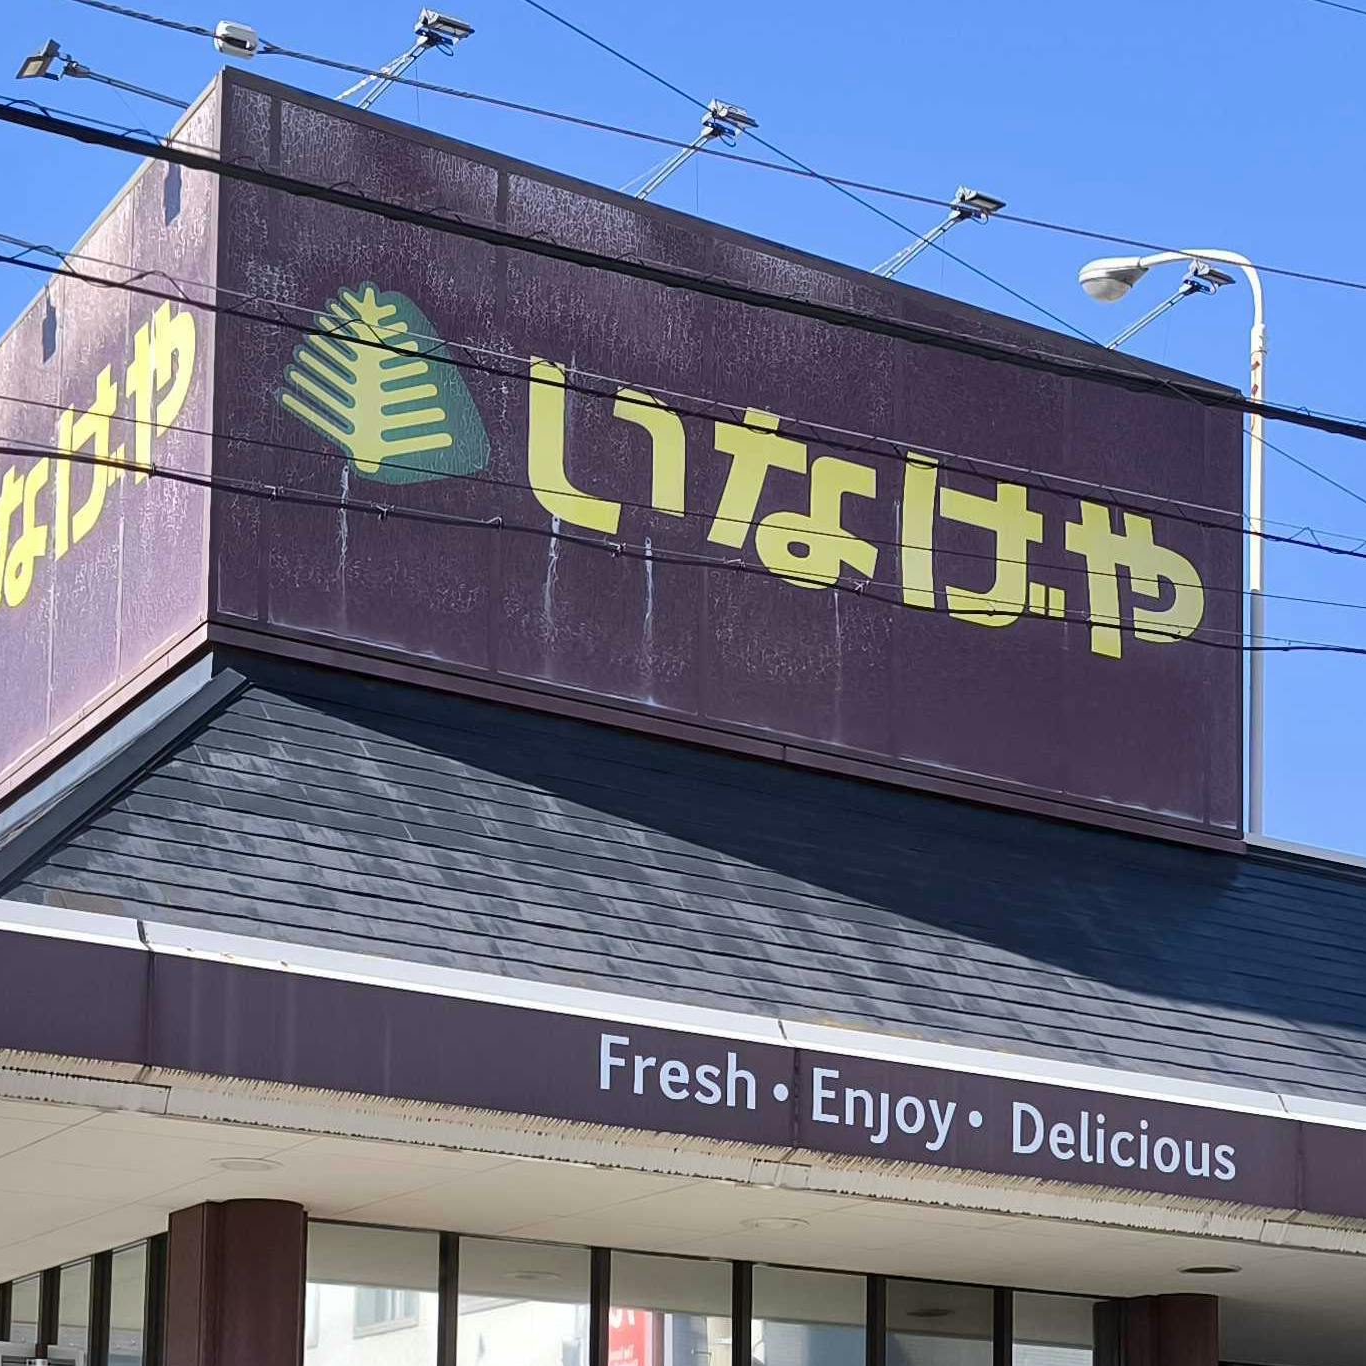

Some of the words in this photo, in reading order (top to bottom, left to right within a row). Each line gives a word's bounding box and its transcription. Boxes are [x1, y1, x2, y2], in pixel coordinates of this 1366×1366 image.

[527, 356, 1204, 658] いなげや
[599, 1033, 757, 1110] Fresh
[812, 1066, 957, 1152] Enjoy
[1012, 1101, 1236, 1182] Delicious
